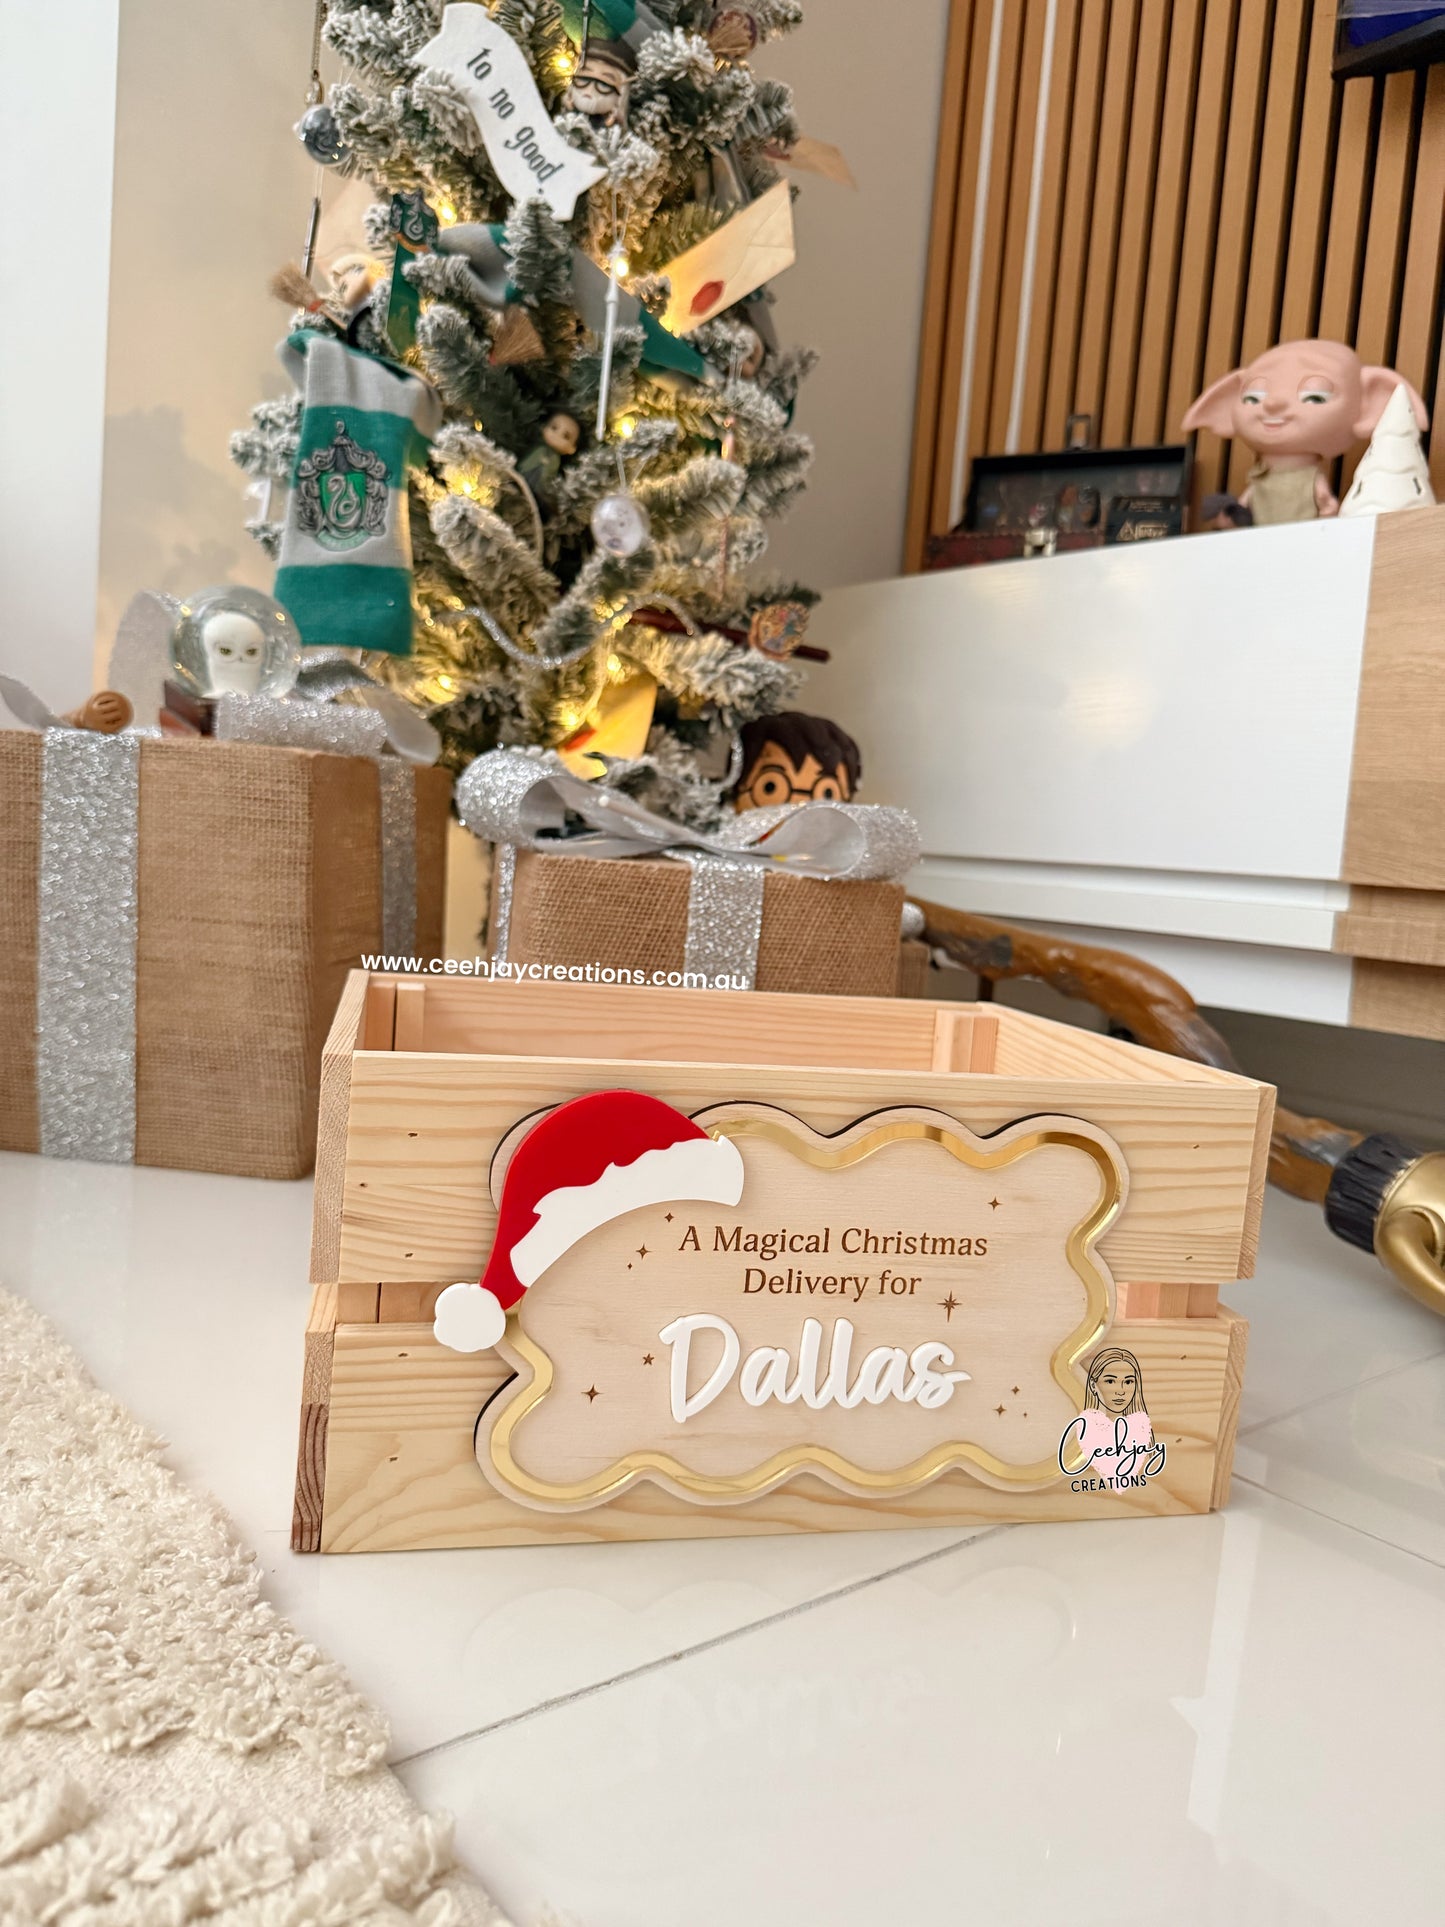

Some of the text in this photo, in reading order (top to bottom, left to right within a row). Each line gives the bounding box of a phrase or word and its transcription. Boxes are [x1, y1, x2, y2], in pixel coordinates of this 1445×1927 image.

[466, 47, 493, 81] to
[489, 88, 516, 120] no
[678, 1225, 989, 1261] A Magical Christmas
[743, 1268, 922, 1303] Delivery for
[658, 1312, 972, 1424] Dallas
